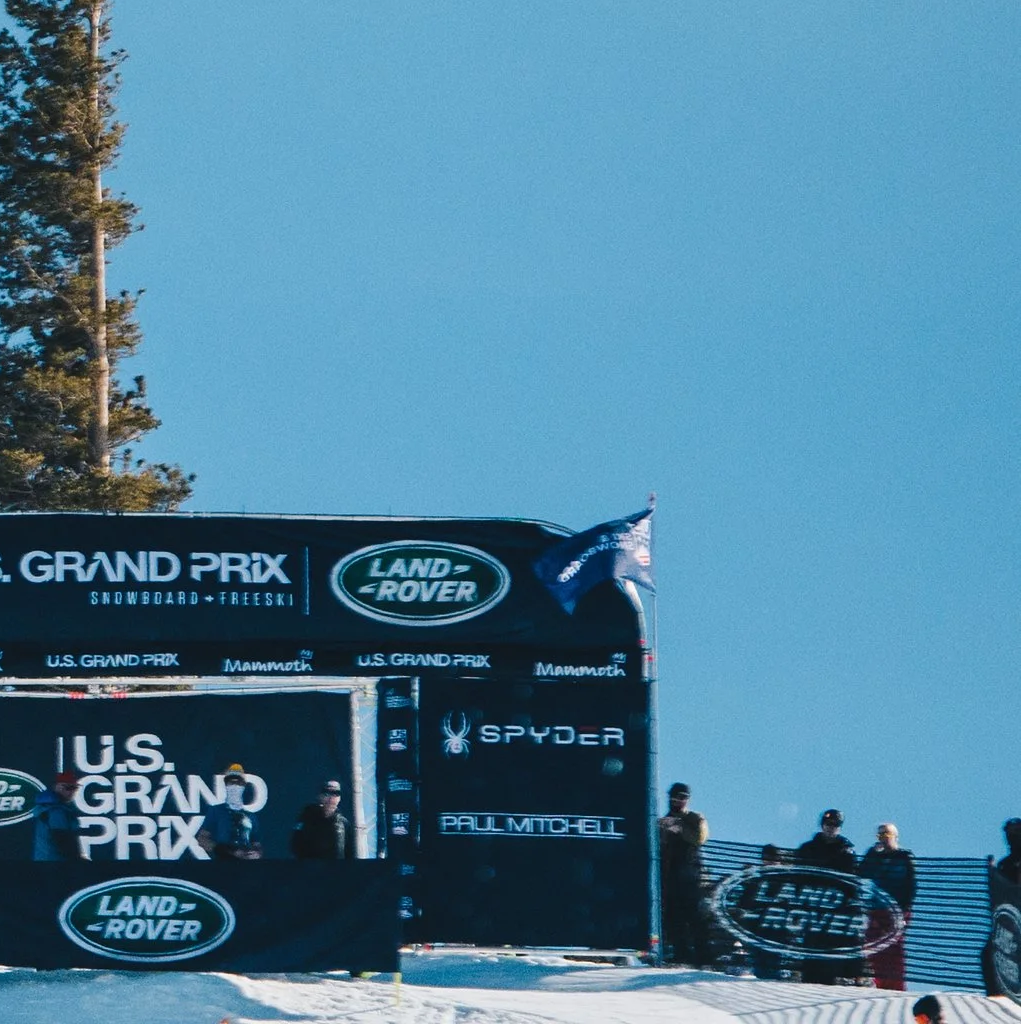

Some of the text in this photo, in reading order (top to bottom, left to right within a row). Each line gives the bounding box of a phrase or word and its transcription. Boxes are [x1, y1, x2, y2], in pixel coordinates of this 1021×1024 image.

[20, 550, 181, 583] GRAND
[190, 551, 292, 584] PRIX
[370, 557, 451, 578] LAND
[91, 591, 199, 605] SNOWBOARD
[219, 592, 293, 606] FREESKI
[376, 580, 478, 602] ROVER
[47, 653, 179, 668] U.S. GRAND PRIX
[223, 658, 313, 673] Mammoth
[358, 653, 491, 668] U.S. GRAND PRIX
[534, 662, 626, 677] Mammoth
[480, 725, 625, 746] SPYDER
[74, 733, 175, 774] U.S.
[74, 774, 268, 815] GRAND
[441, 816, 625, 836] PAUL MITCHELL
[78, 816, 212, 860] PRIX
[97, 895, 178, 916] LAND
[754, 881, 845, 909] LAND
[103, 918, 202, 941] ROVER
[761, 907, 870, 938] ROVER
